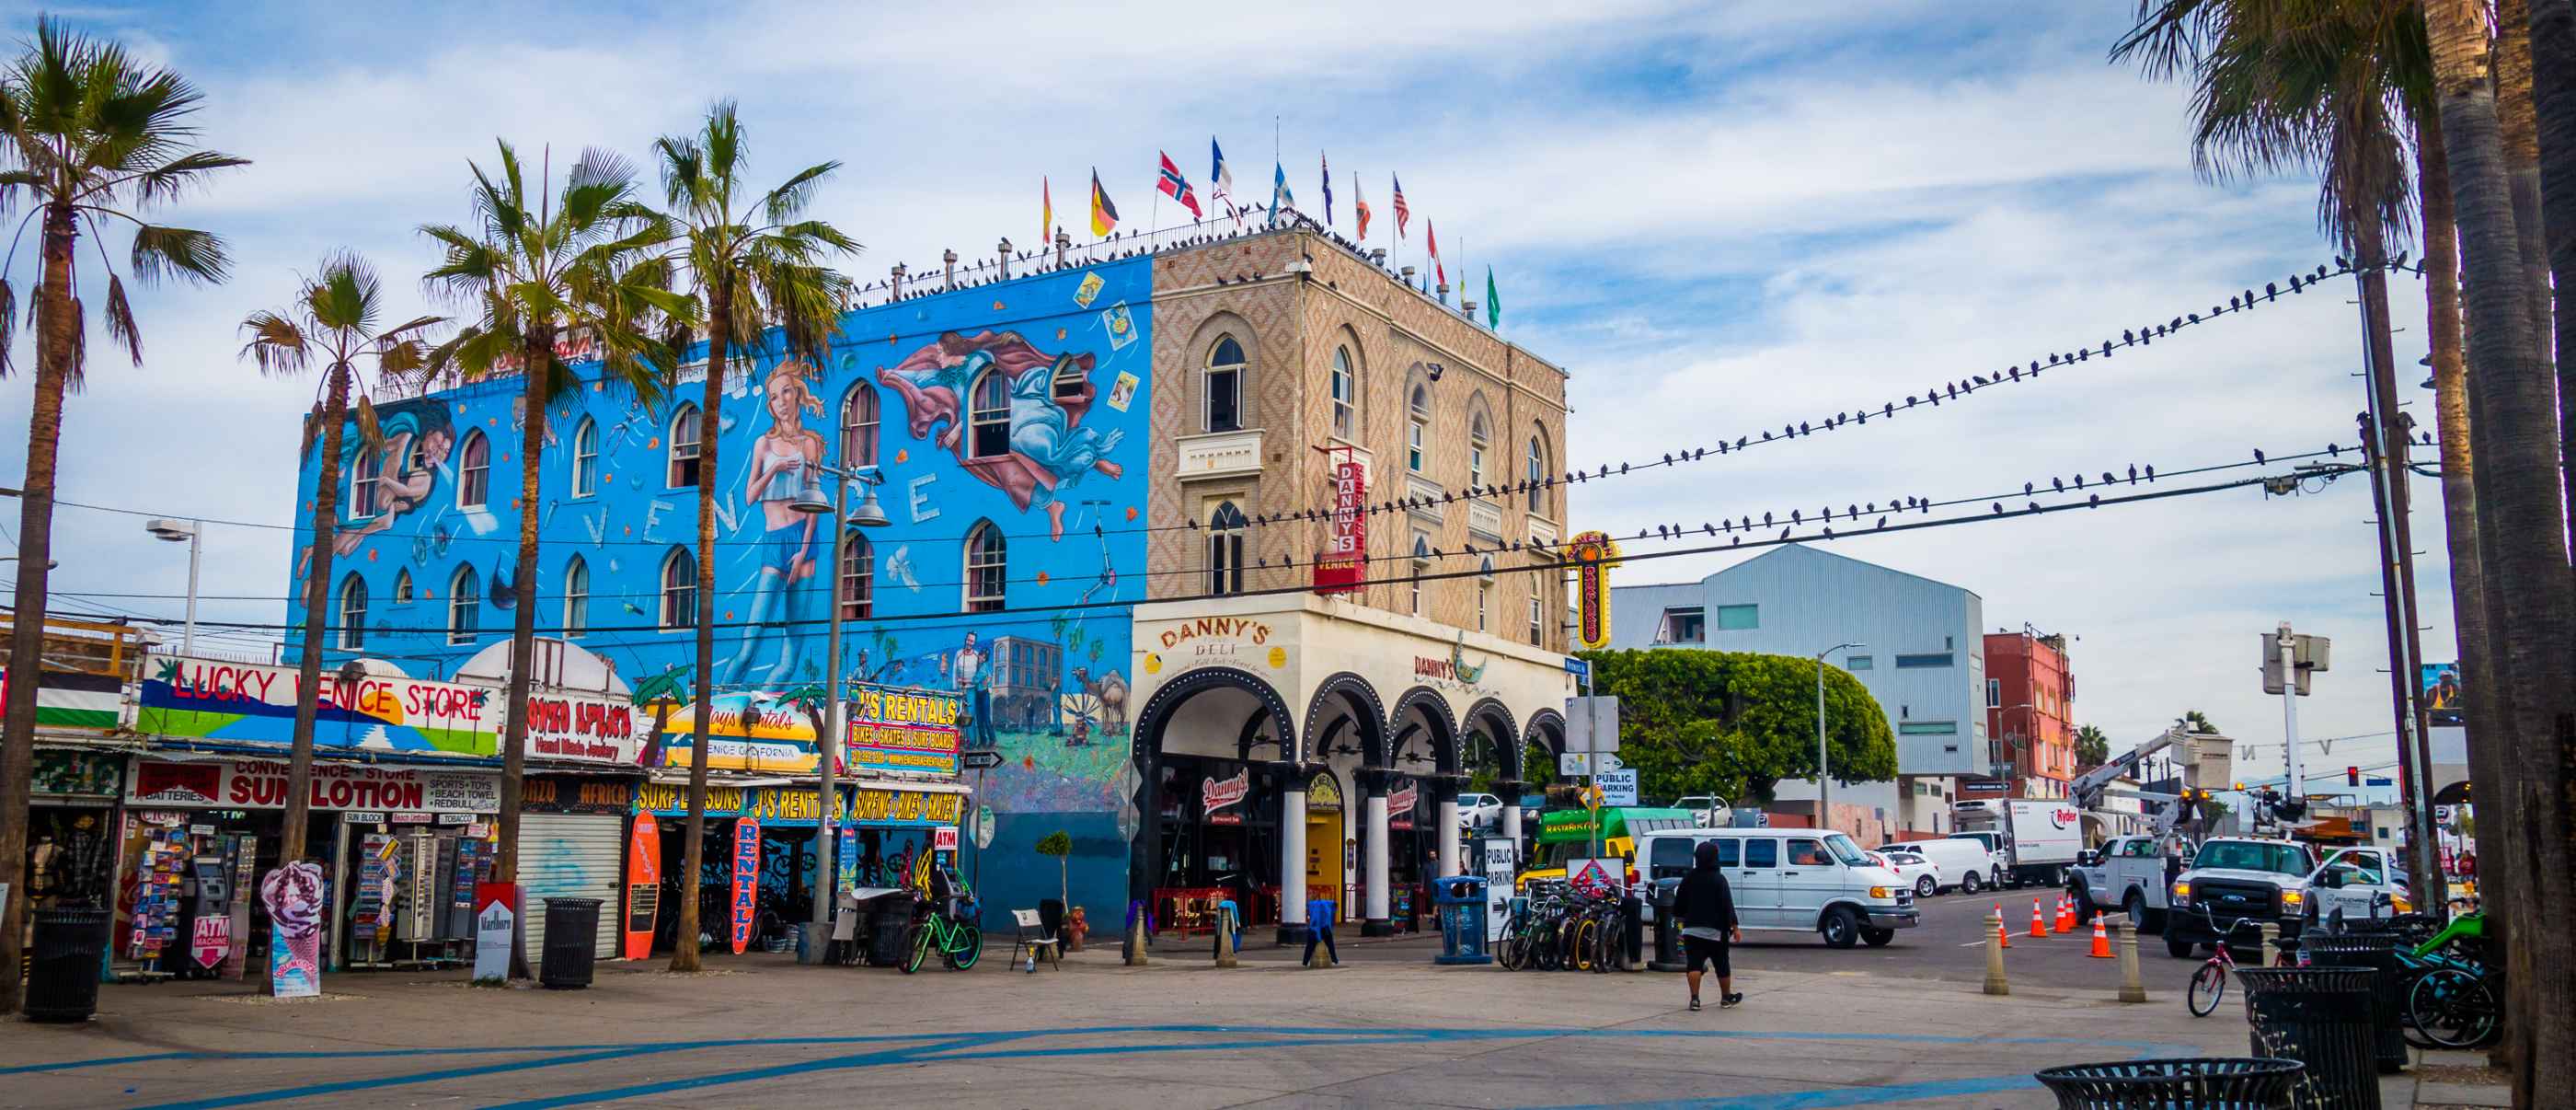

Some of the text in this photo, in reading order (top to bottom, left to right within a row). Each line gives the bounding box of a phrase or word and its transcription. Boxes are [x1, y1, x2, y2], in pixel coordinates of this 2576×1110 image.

[1160, 618, 1272, 649] DANNY'S
[1195, 644, 1236, 656] DELI
[1414, 655, 1455, 681] DANNY'S
[172, 662, 278, 703] LUCKY
[405, 684, 483, 721] STORE
[525, 697, 571, 738] ONZO
[885, 692, 958, 726] RENTALS
[535, 736, 559, 754] Hand
[561, 737, 585, 756] Made
[853, 725, 873, 744] BIKES
[879, 726, 906, 747] SKATES
[913, 730, 930, 749] SURF
[931, 731, 957, 751] BOARDS
[707, 744, 736, 756] ENICE
[235, 760, 351, 778] CONVEENCE
[430, 780, 492, 790] SPORTS TOYS
[1596, 774, 1631, 782] PUBLIC
[310, 779, 423, 810] LOTION
[434, 790, 497, 800] BEACH TOWEL
[580, 782, 627, 805] AFRICA
[638, 783, 742, 812] SURF LSONS
[434, 799, 472, 808] REDBULL
[754, 787, 843, 821] J'S RENTS
[853, 791, 957, 821] SURFING BIKES SKATES
[346, 814, 383, 823] SUN BLOCK
[394, 814, 410, 822] Beach
[444, 814, 472, 824] TOBACCO
[2057, 808, 2076, 825] Ryder
[937, 831, 956, 847] ATM
[1487, 849, 1512, 863] PUBLIC
[1487, 872, 1513, 885] PARKING
[197, 920, 229, 936] ATM
[480, 911, 512, 931] Marlboro
[196, 936, 228, 946] MACHINE
